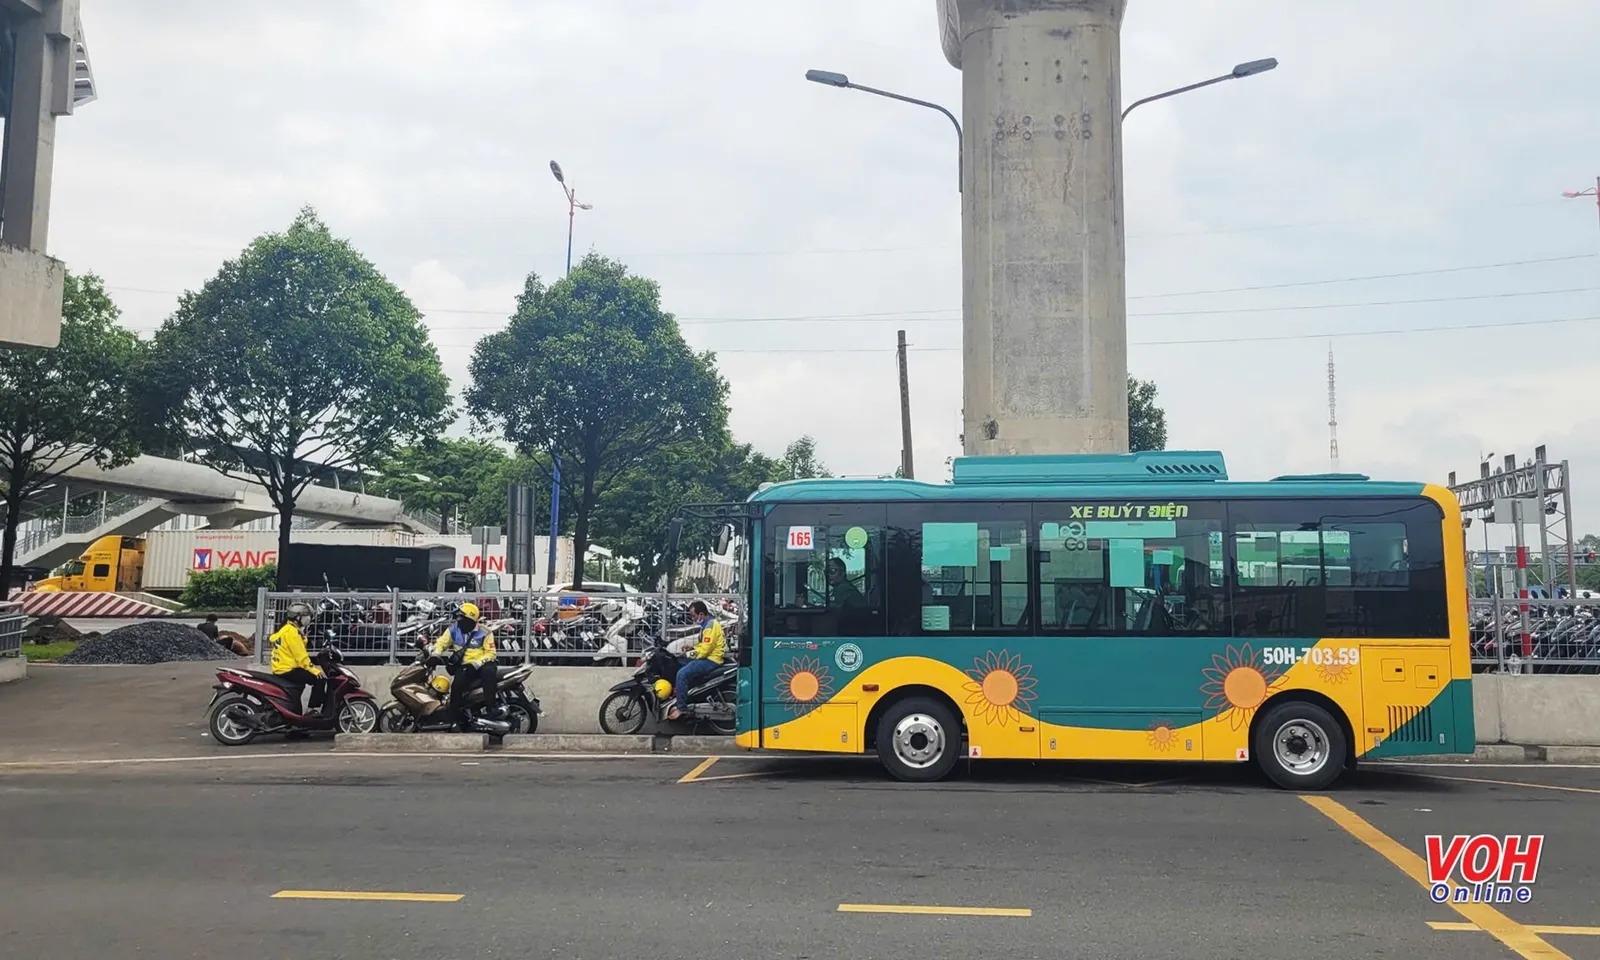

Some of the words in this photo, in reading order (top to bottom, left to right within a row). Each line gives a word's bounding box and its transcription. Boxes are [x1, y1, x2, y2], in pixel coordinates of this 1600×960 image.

[1070, 506, 1093, 518] XE
[1097, 503, 1145, 518] BUÝT
[790, 532, 811, 546] 165
[217, 550, 277, 567] YANG
[463, 555, 507, 572] MN
[1263, 647, 1360, 665] 50H-703.59
